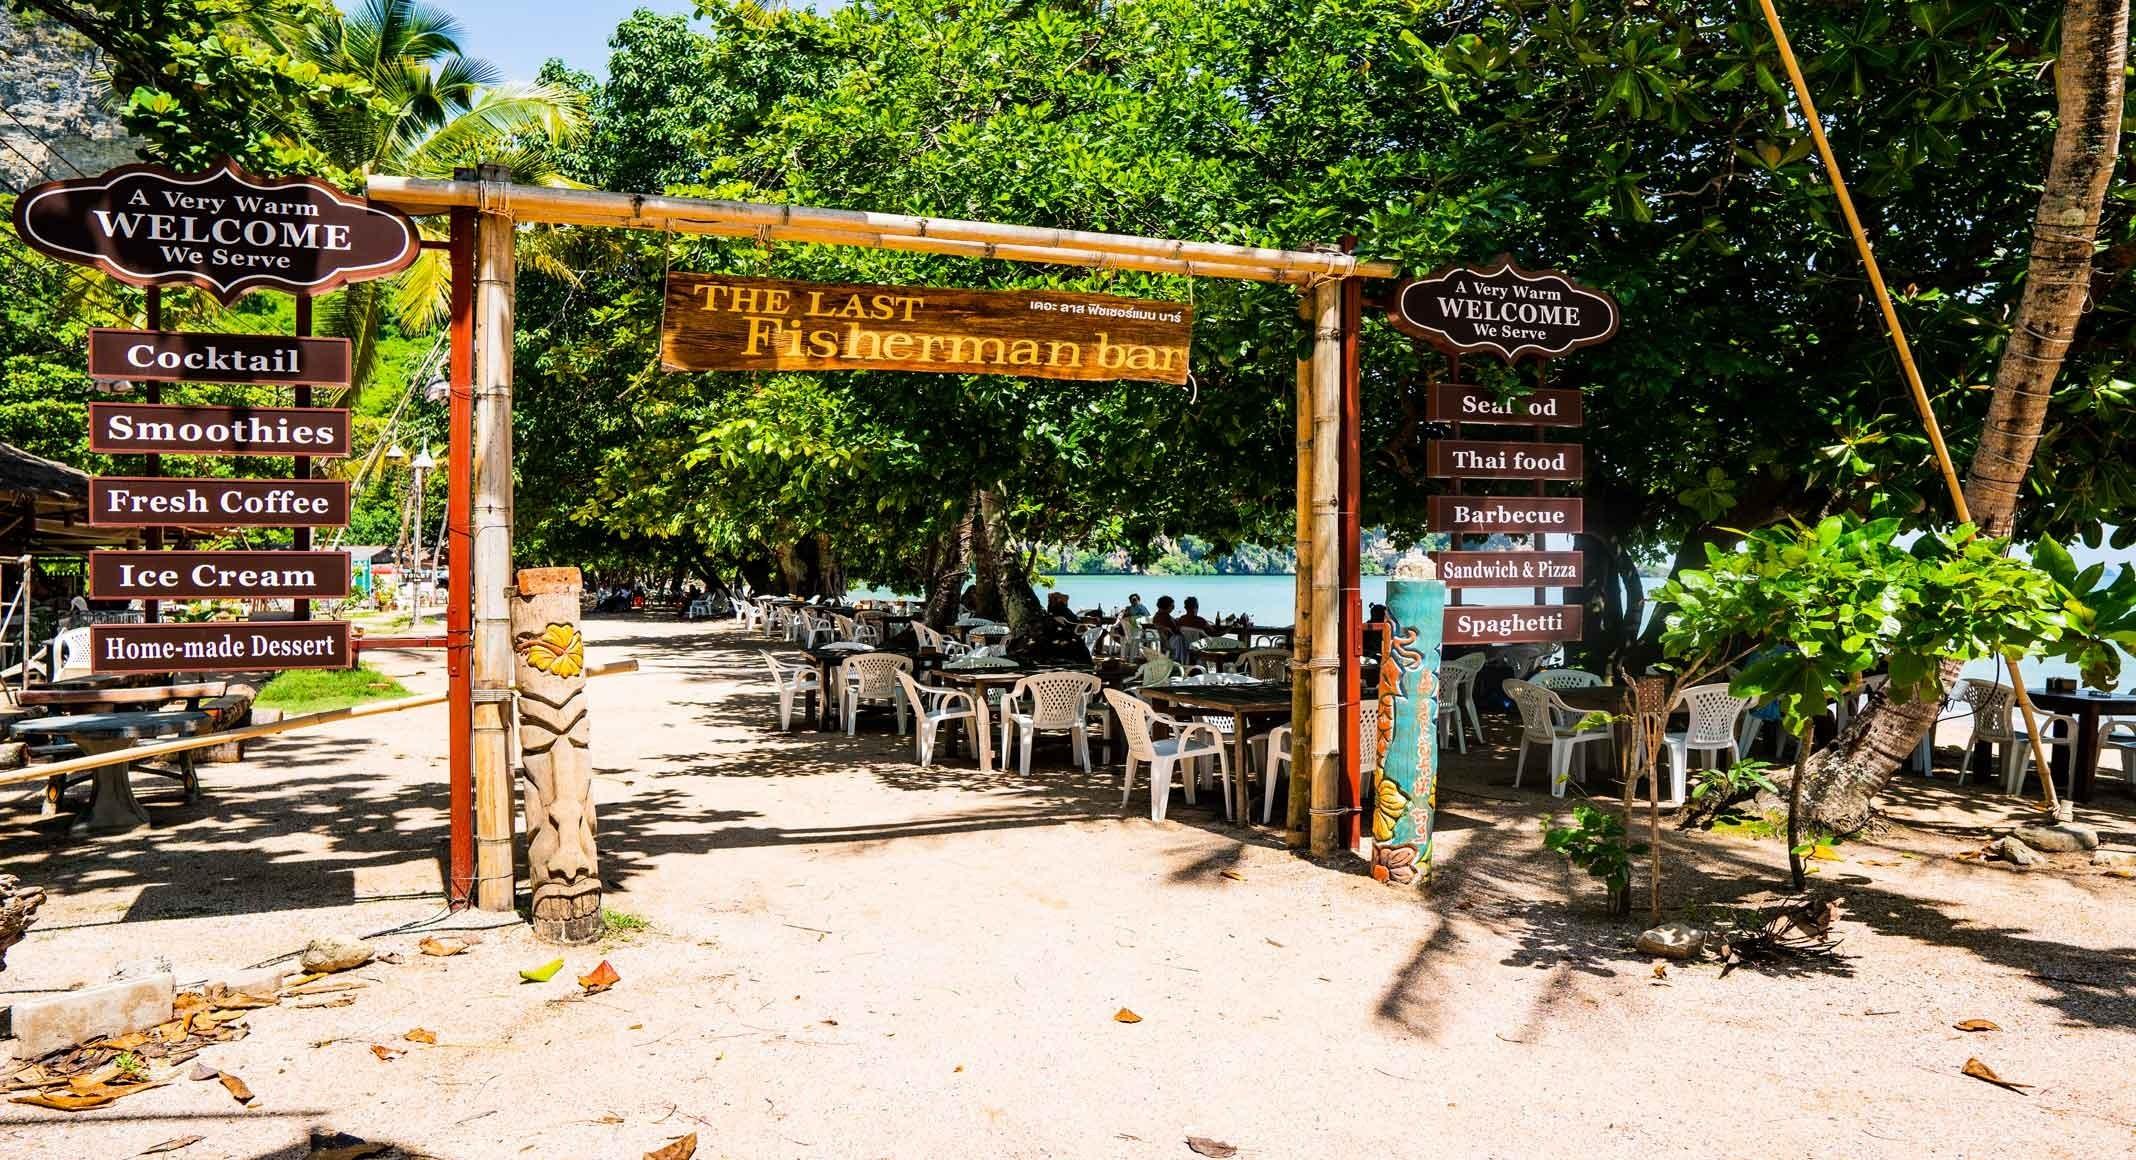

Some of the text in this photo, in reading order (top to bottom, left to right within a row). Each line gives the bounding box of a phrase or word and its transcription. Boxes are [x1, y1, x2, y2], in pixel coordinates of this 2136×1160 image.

[128, 188, 320, 217] A Very Warm
[93, 209, 352, 252] WELCOME
[160, 246, 292, 269] We Serve
[693, 283, 924, 323] THE LAST
[1455, 281, 1561, 301] A Very Warm
[1437, 296, 1581, 327] WELCOME
[742, 316, 1184, 372] Fisherman bar
[1473, 323, 1547, 340] We Serve
[126, 344, 301, 374] Cocktail
[1462, 395, 1558, 417] Seafod
[108, 414, 335, 445] Smoothies
[1452, 450, 1566, 471] Thai food
[107, 488, 330, 515] Fresh Coffee
[1454, 505, 1565, 524] Barbecue
[119, 563, 317, 588] Ice Cream
[1444, 560, 1577, 579] Sandwich & Pizza
[1457, 613, 1563, 637] Spaghetti
[105, 634, 335, 661] Home-made Dessert
